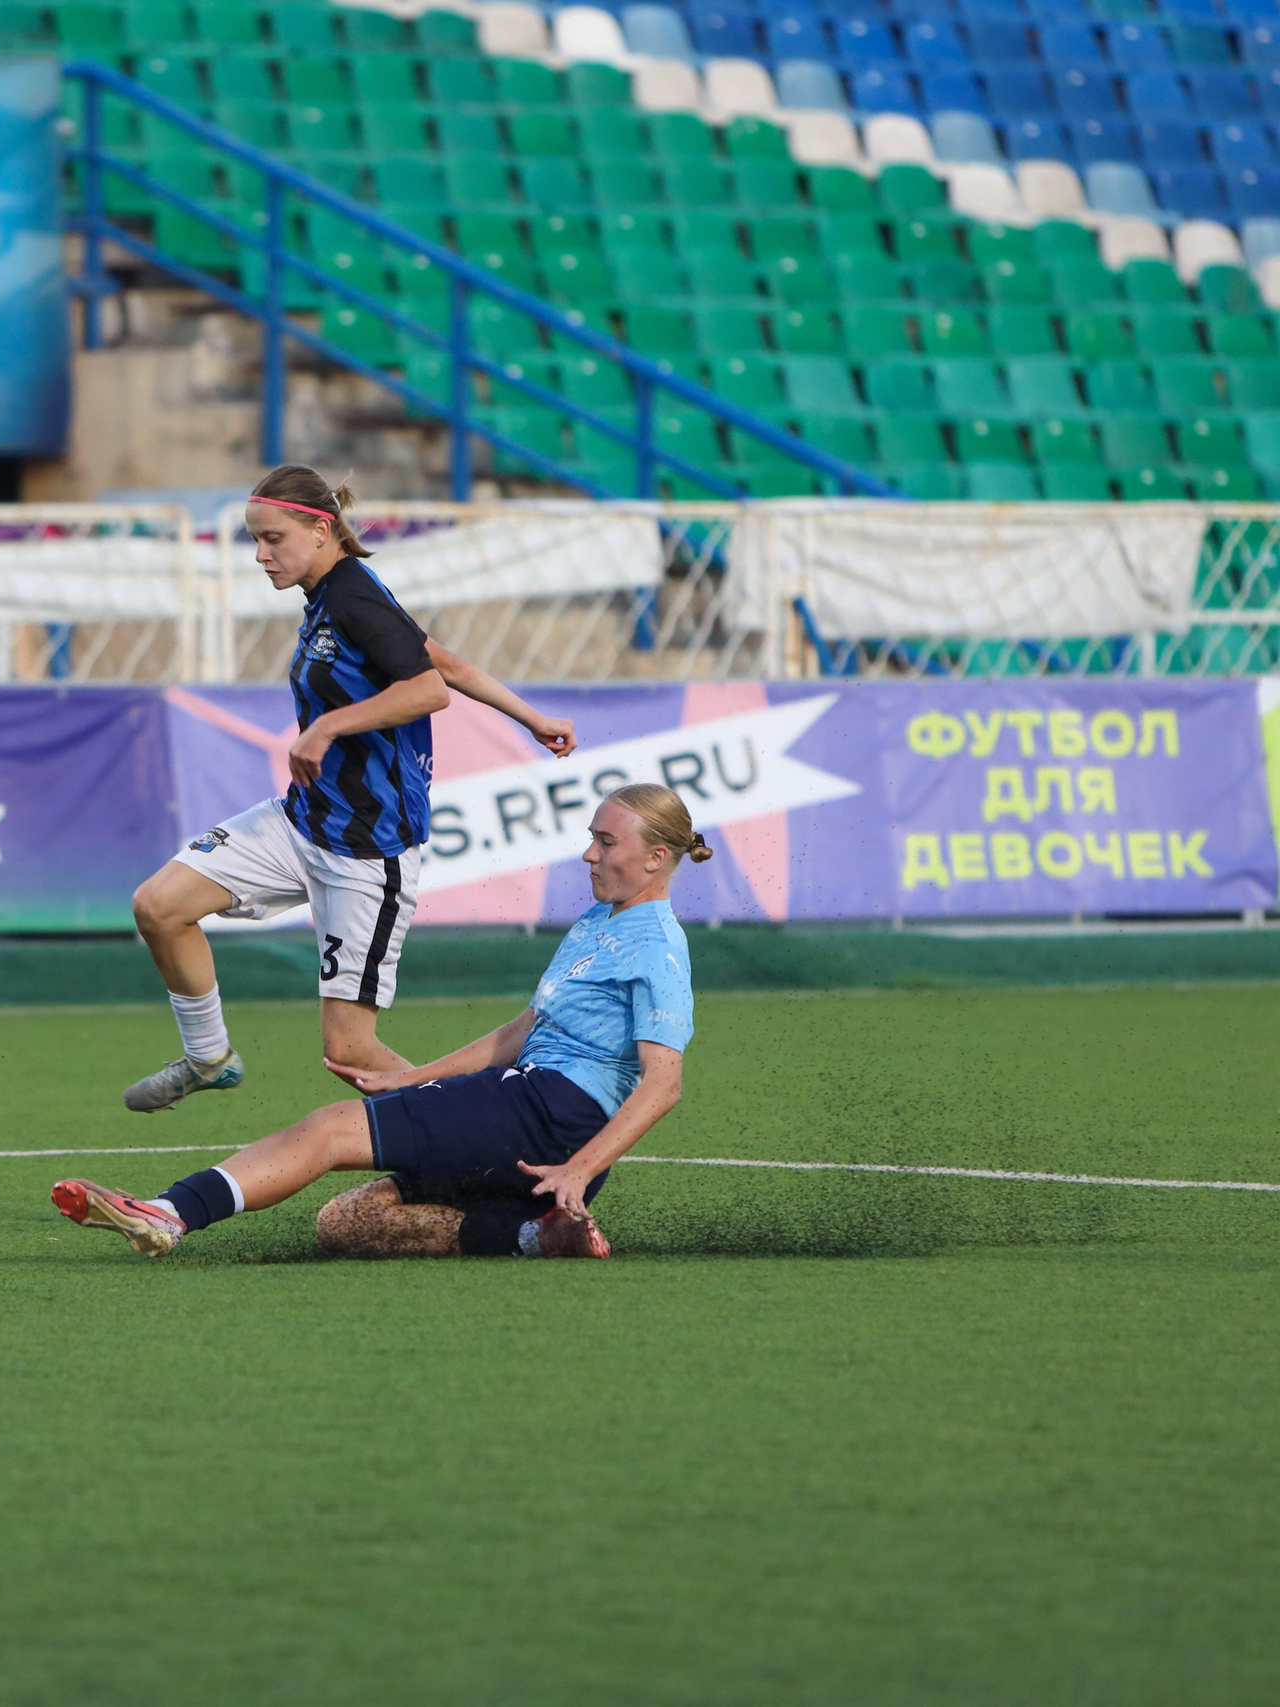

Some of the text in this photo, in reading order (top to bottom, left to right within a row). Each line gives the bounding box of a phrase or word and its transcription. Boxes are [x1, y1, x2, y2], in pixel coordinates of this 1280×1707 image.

[907, 709, 1180, 759] ФУТБОЛ
[981, 767, 1117, 824] ДЛЯ
[901, 830, 1214, 891] ДЕВОЧЕК
[320, 933, 343, 982] 3
